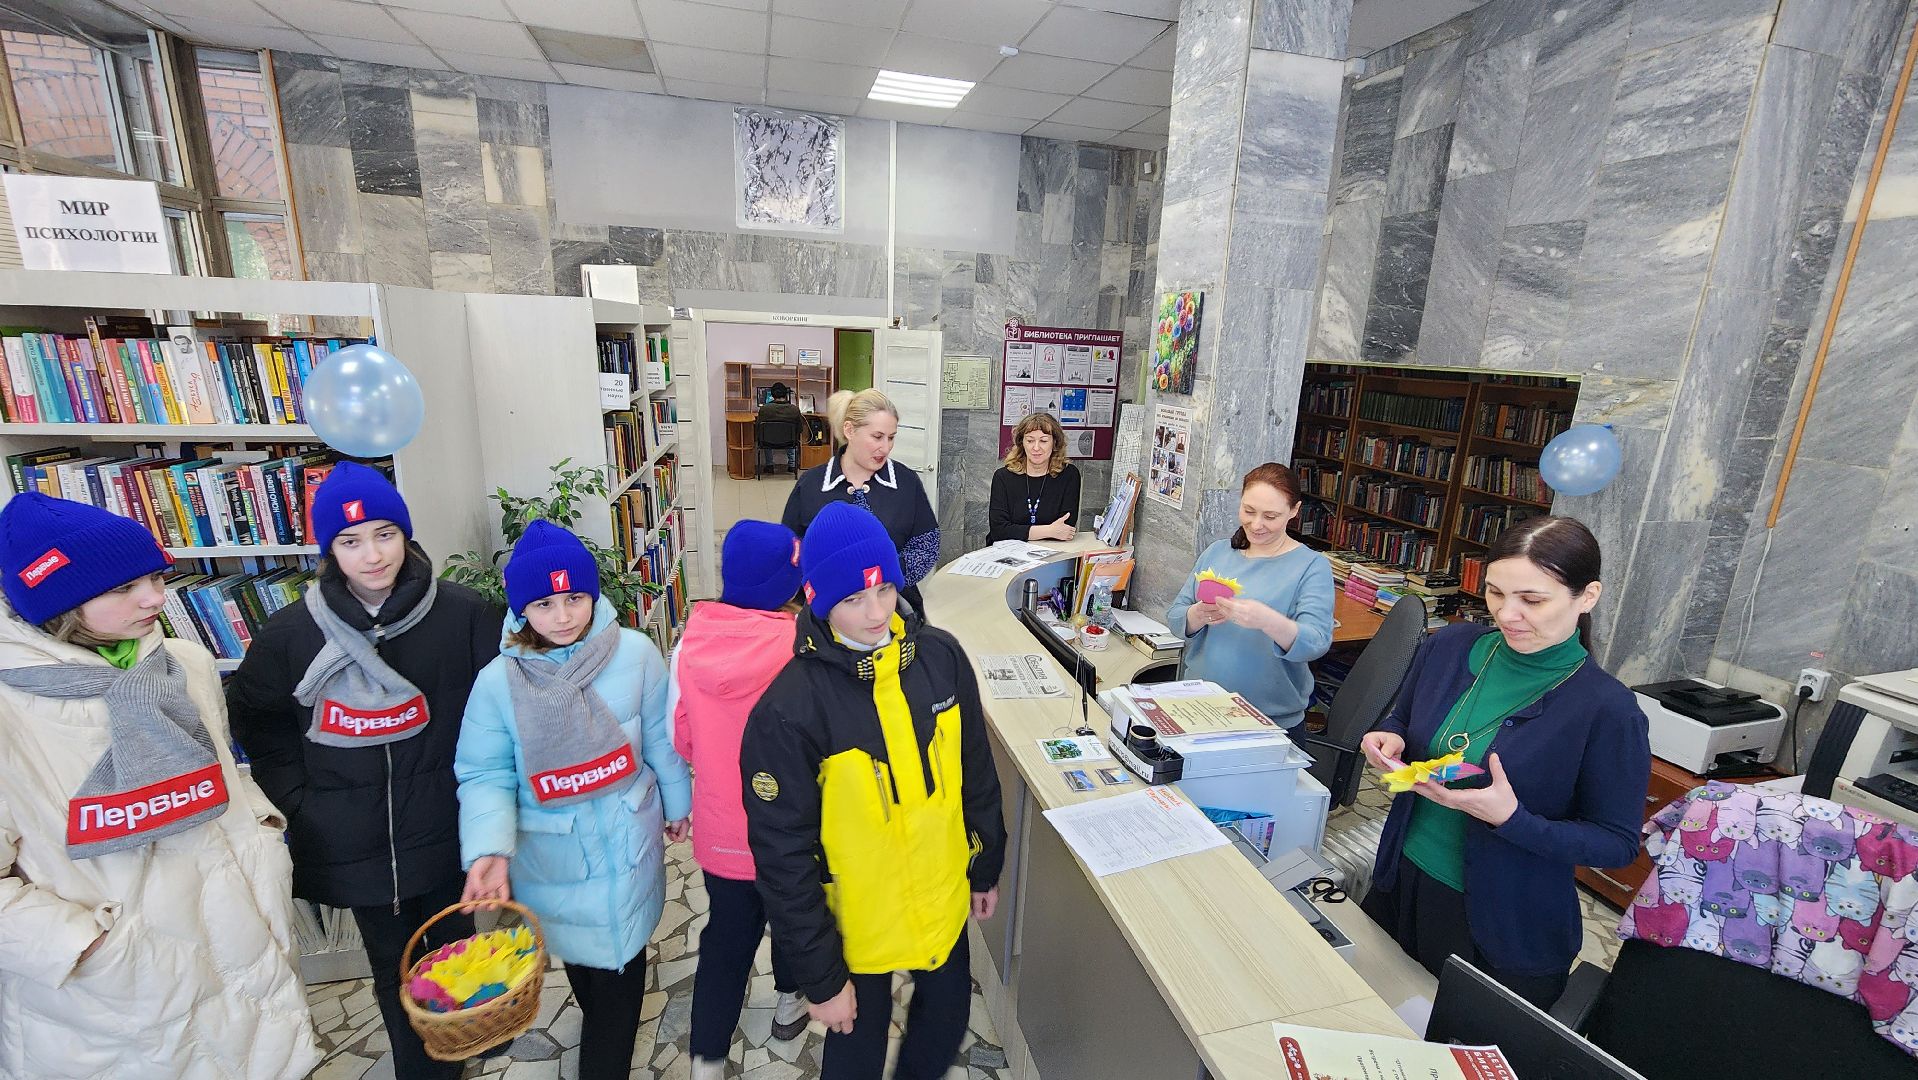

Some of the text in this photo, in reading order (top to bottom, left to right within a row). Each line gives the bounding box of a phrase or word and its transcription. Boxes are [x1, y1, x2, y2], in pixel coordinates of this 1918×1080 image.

[58, 199, 110, 217] МИР
[24, 226, 159, 244] ПСИХОЛОГИИ
[1023, 331, 1121, 342] БИБЛИОТЕКА ПРИГЛАШАЕТ
[614, 379, 624, 387] 20
[25, 554, 60, 581] Первые
[329, 705, 419, 735] Первые
[540, 753, 628, 794] Первые
[79, 778, 216, 831] Первые
